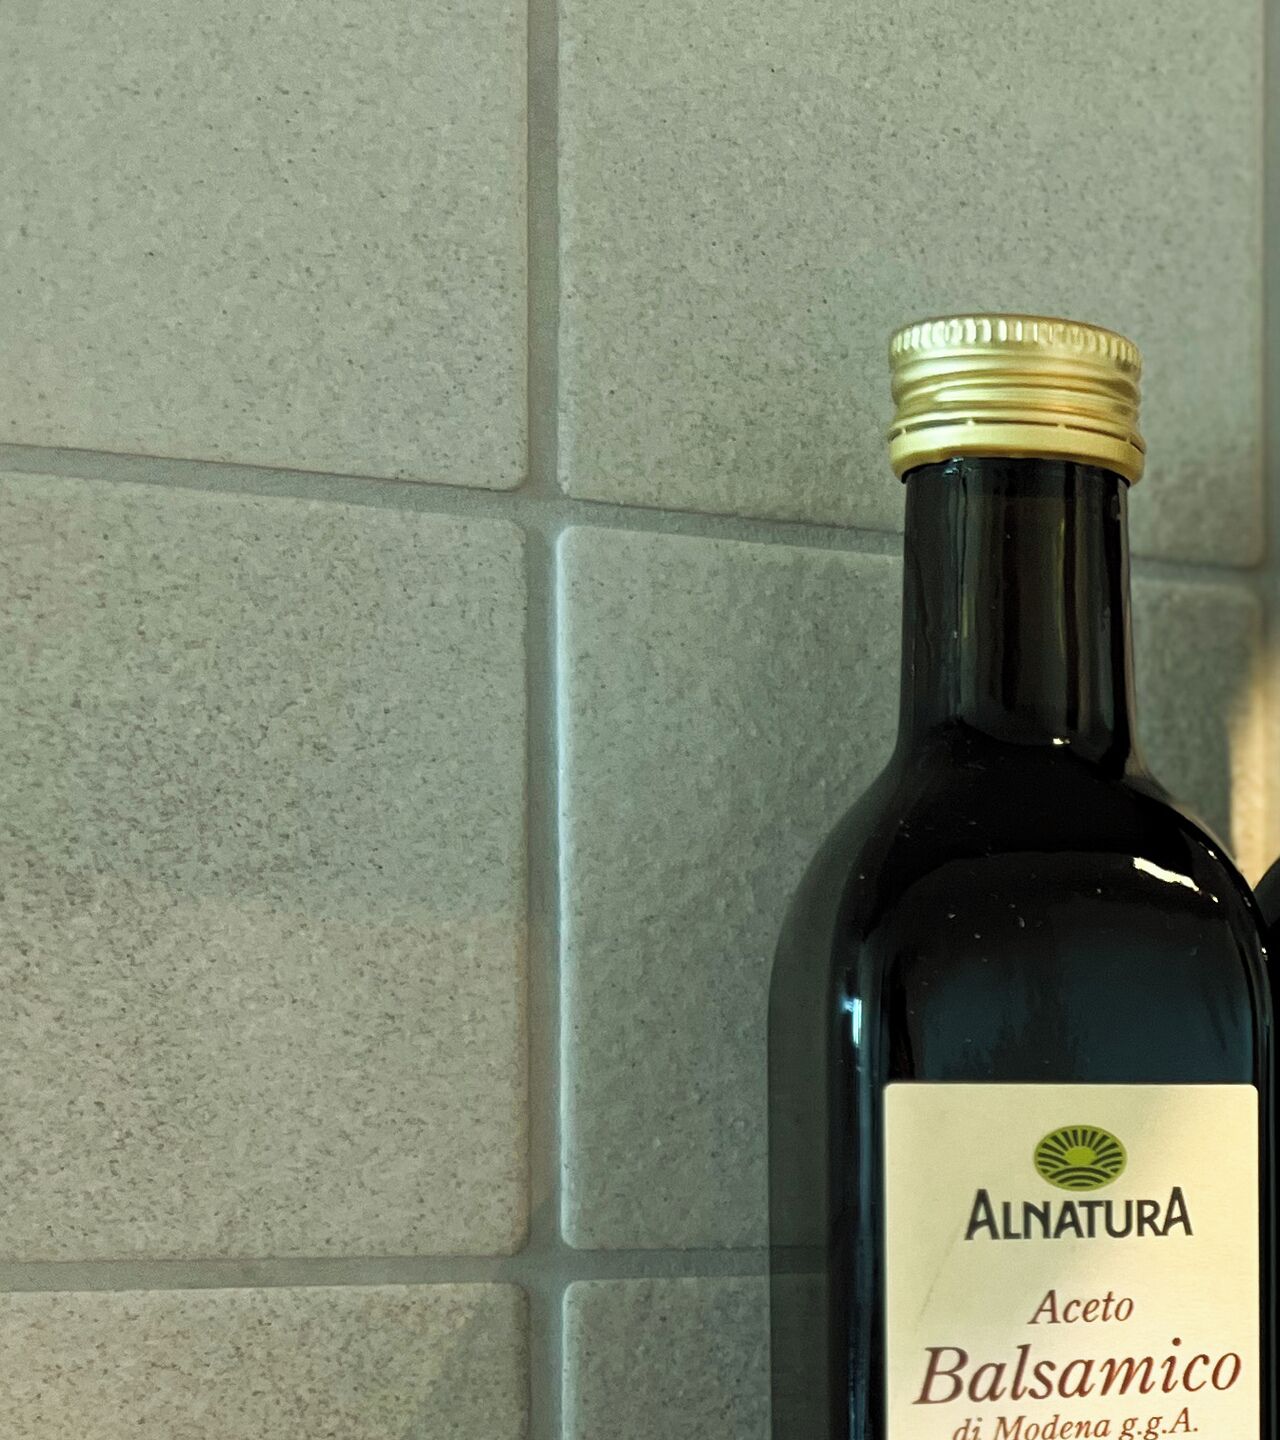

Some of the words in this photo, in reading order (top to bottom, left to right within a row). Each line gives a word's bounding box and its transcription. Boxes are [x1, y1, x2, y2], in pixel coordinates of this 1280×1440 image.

[964, 1186, 1193, 1241] ALNATURA
[1028, 1290, 1134, 1324] Aceto
[913, 1337, 1242, 1405] Balsamico
